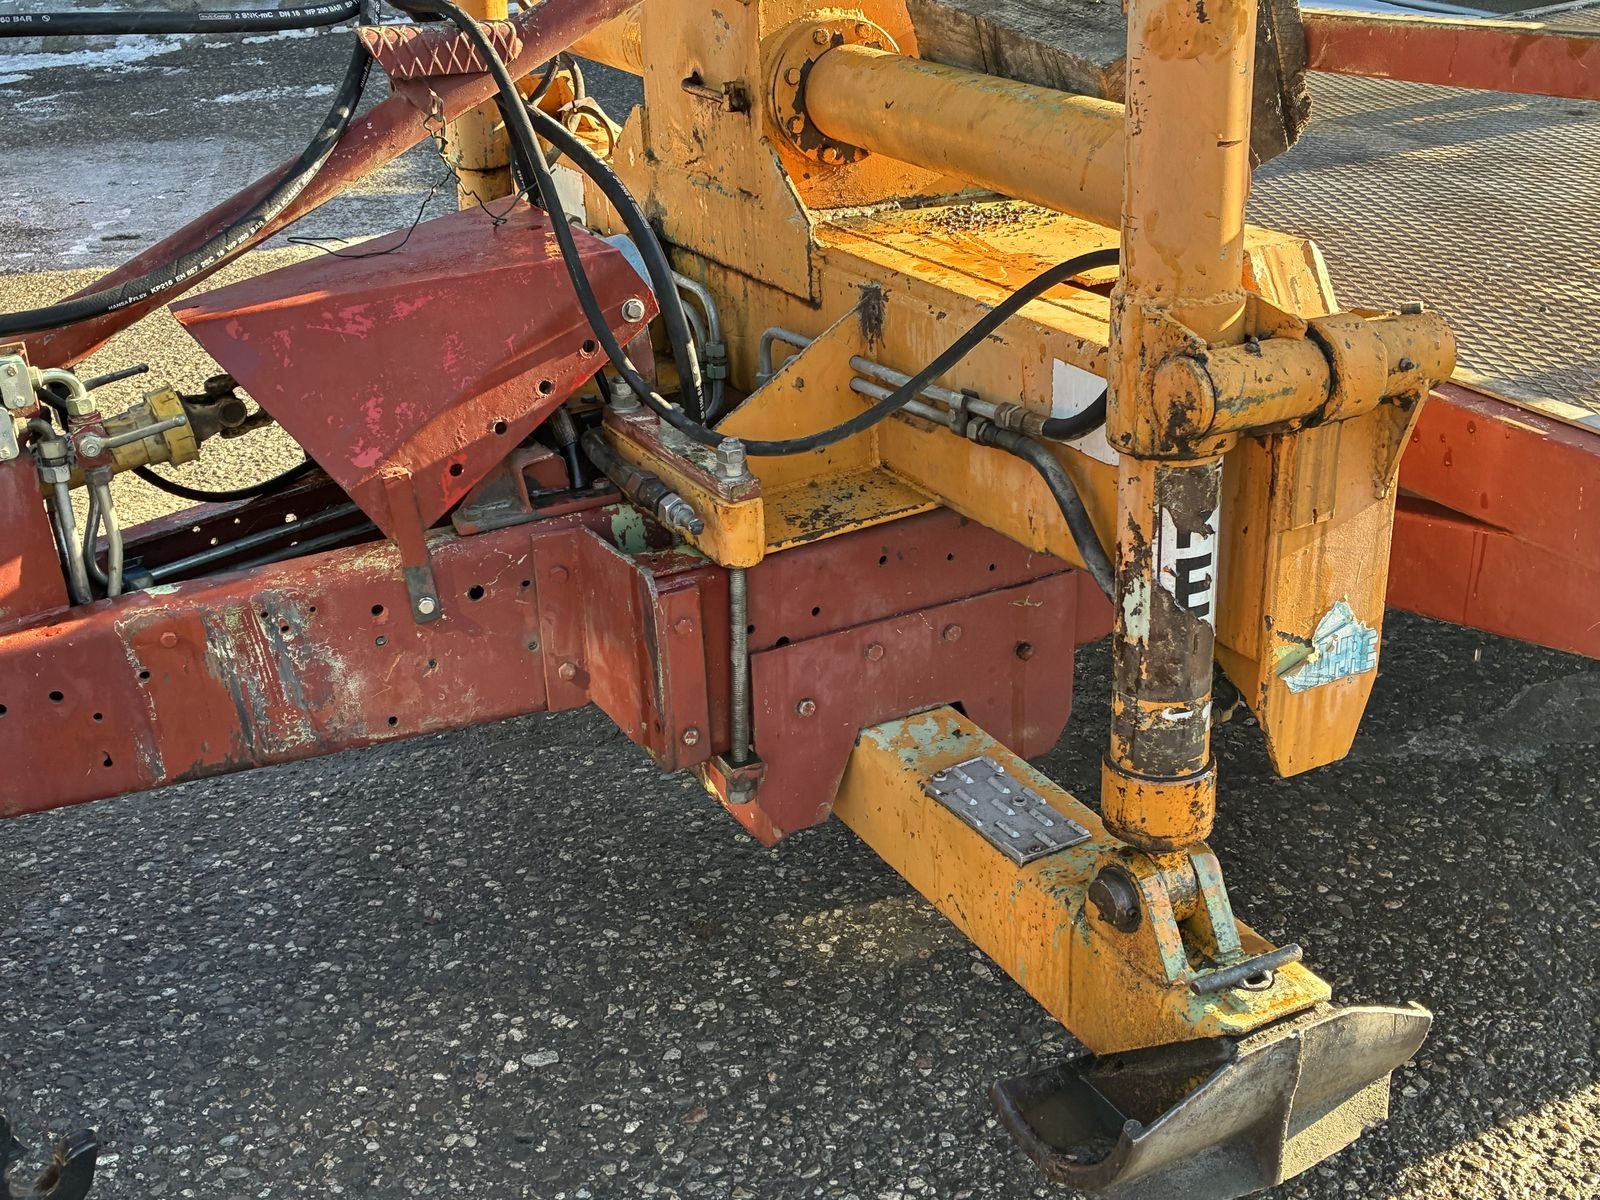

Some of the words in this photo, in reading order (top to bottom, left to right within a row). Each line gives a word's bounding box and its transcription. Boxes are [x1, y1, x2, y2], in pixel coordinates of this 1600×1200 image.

[329, 4, 343, 13] BAR
[12, 15, 33, 23] BAR
[175, 272, 187, 283] EN
[250, 219, 265, 235] BAR
